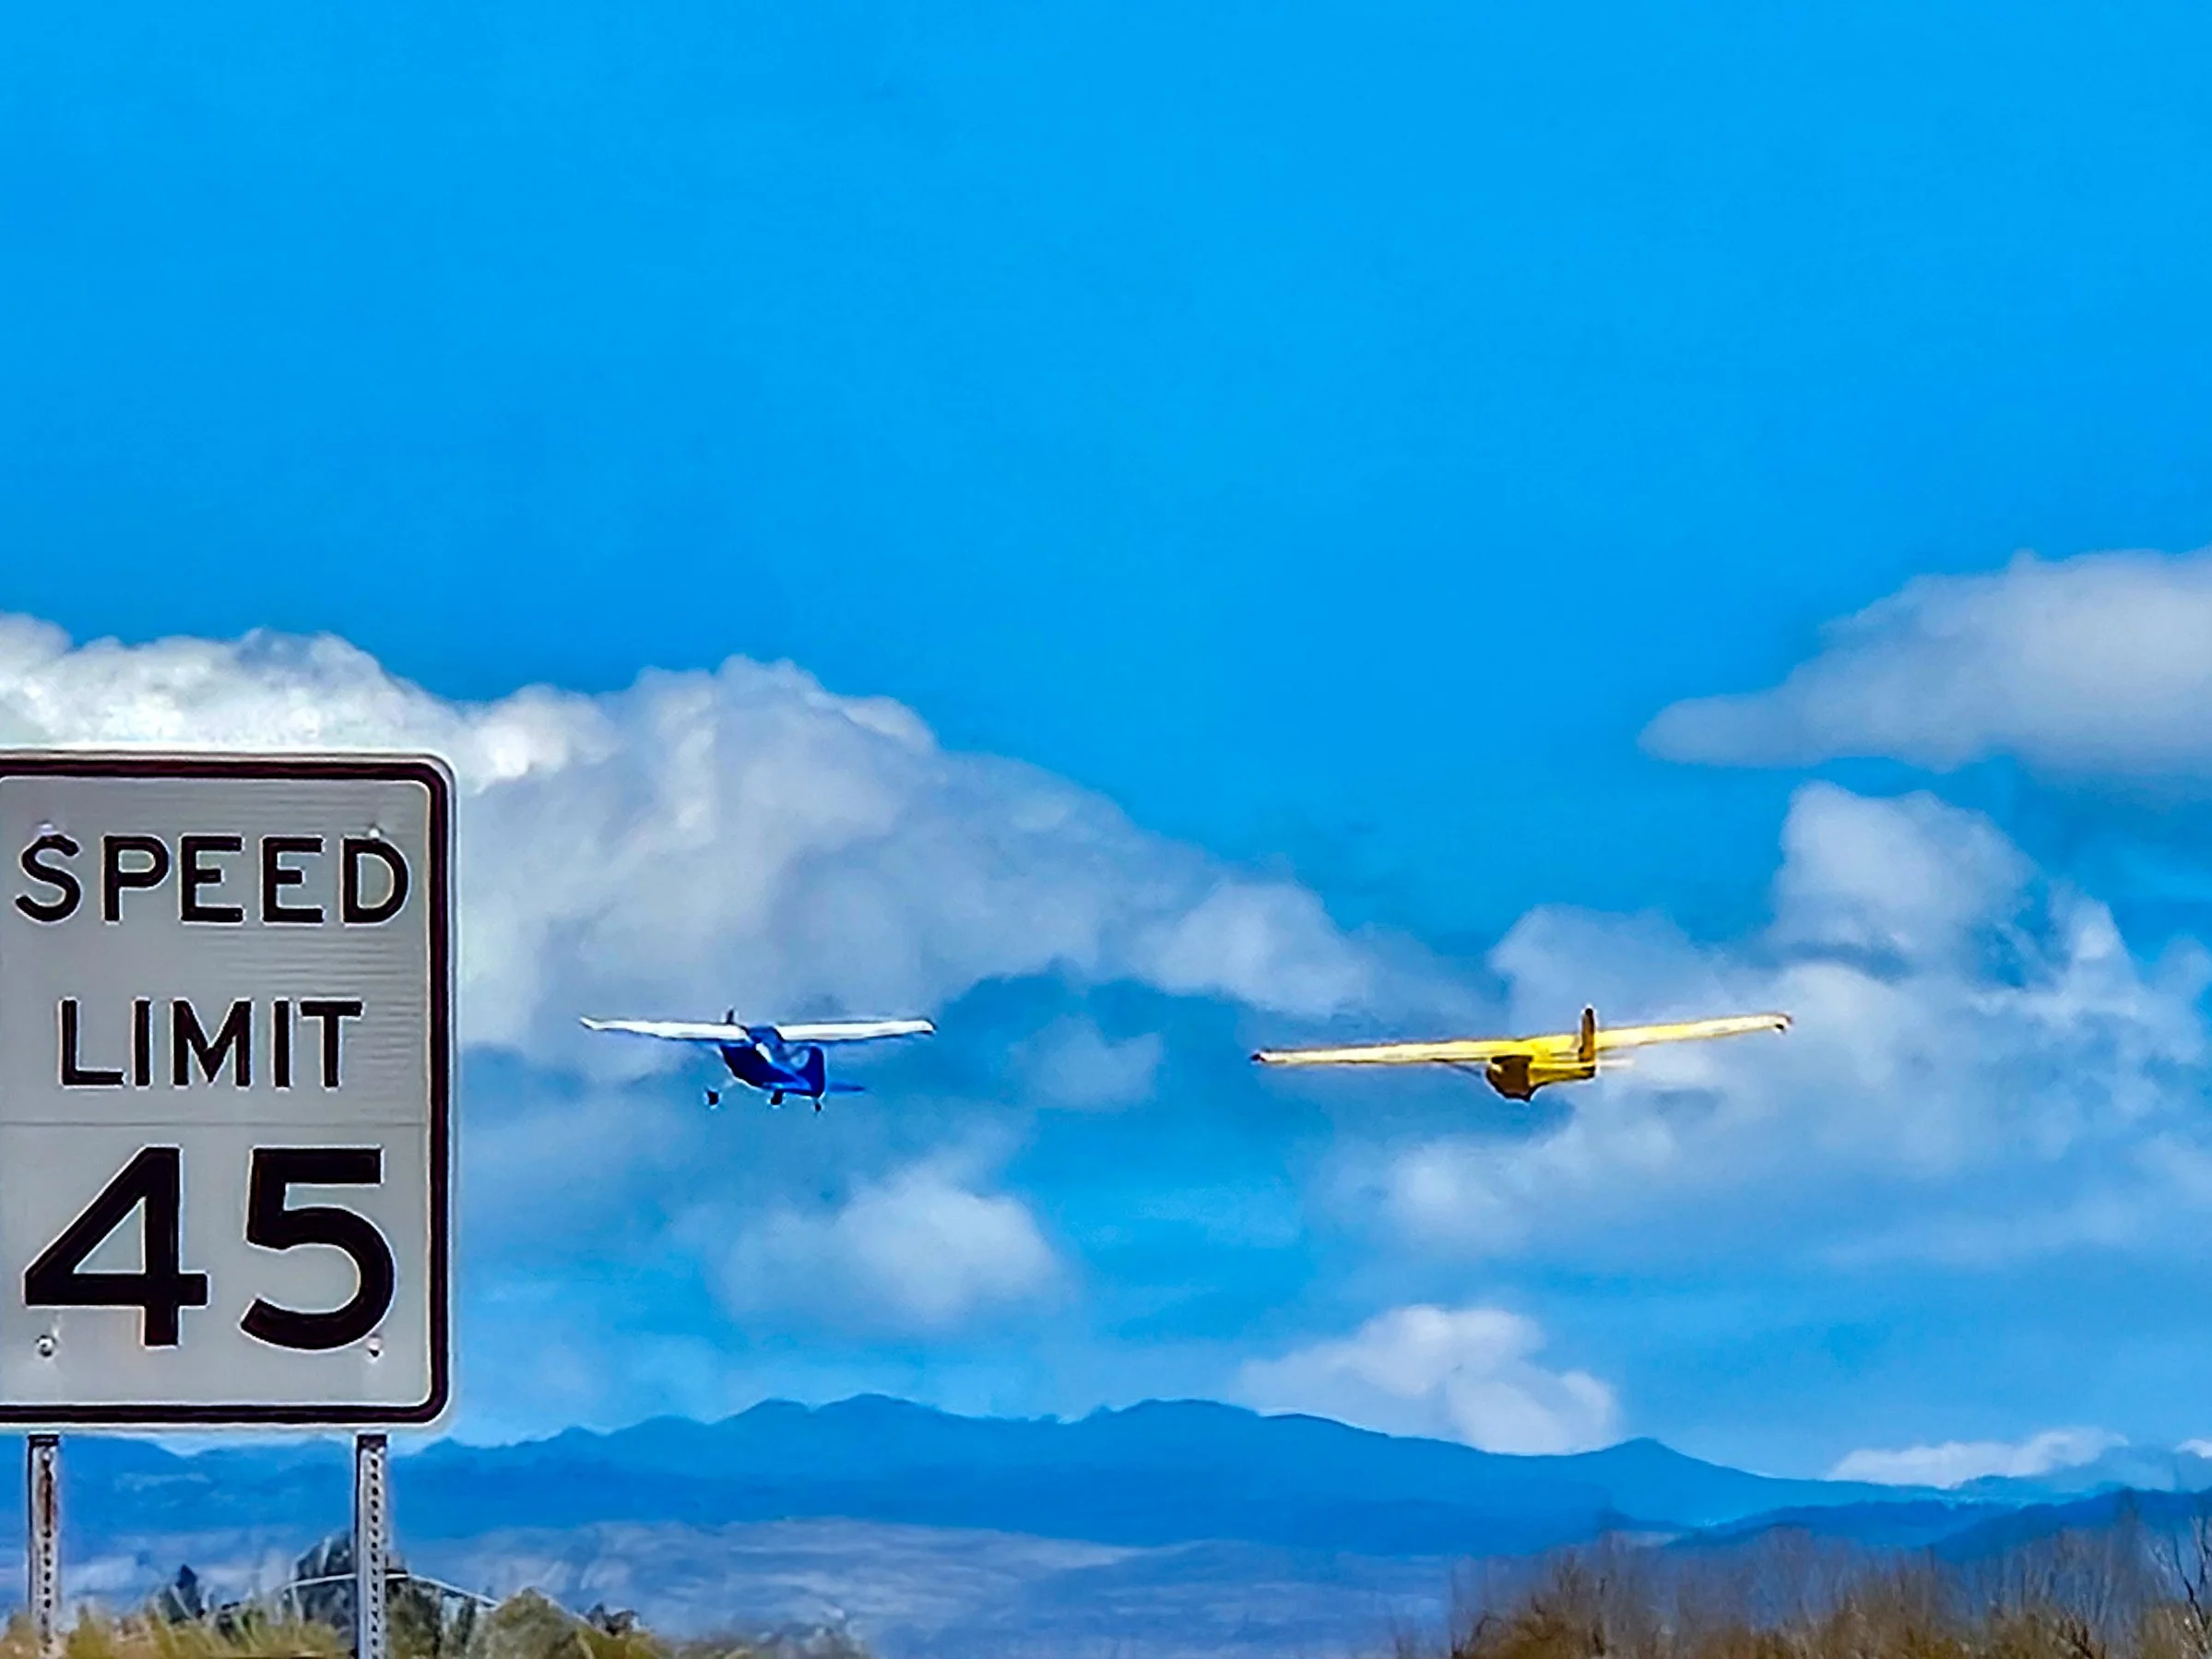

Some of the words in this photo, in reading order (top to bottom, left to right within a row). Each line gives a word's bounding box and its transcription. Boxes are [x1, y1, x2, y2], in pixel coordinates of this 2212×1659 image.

[15, 833, 409, 925] SPEED
[60, 999, 364, 1089] LIMIT
[23, 1145, 396, 1351] 45
